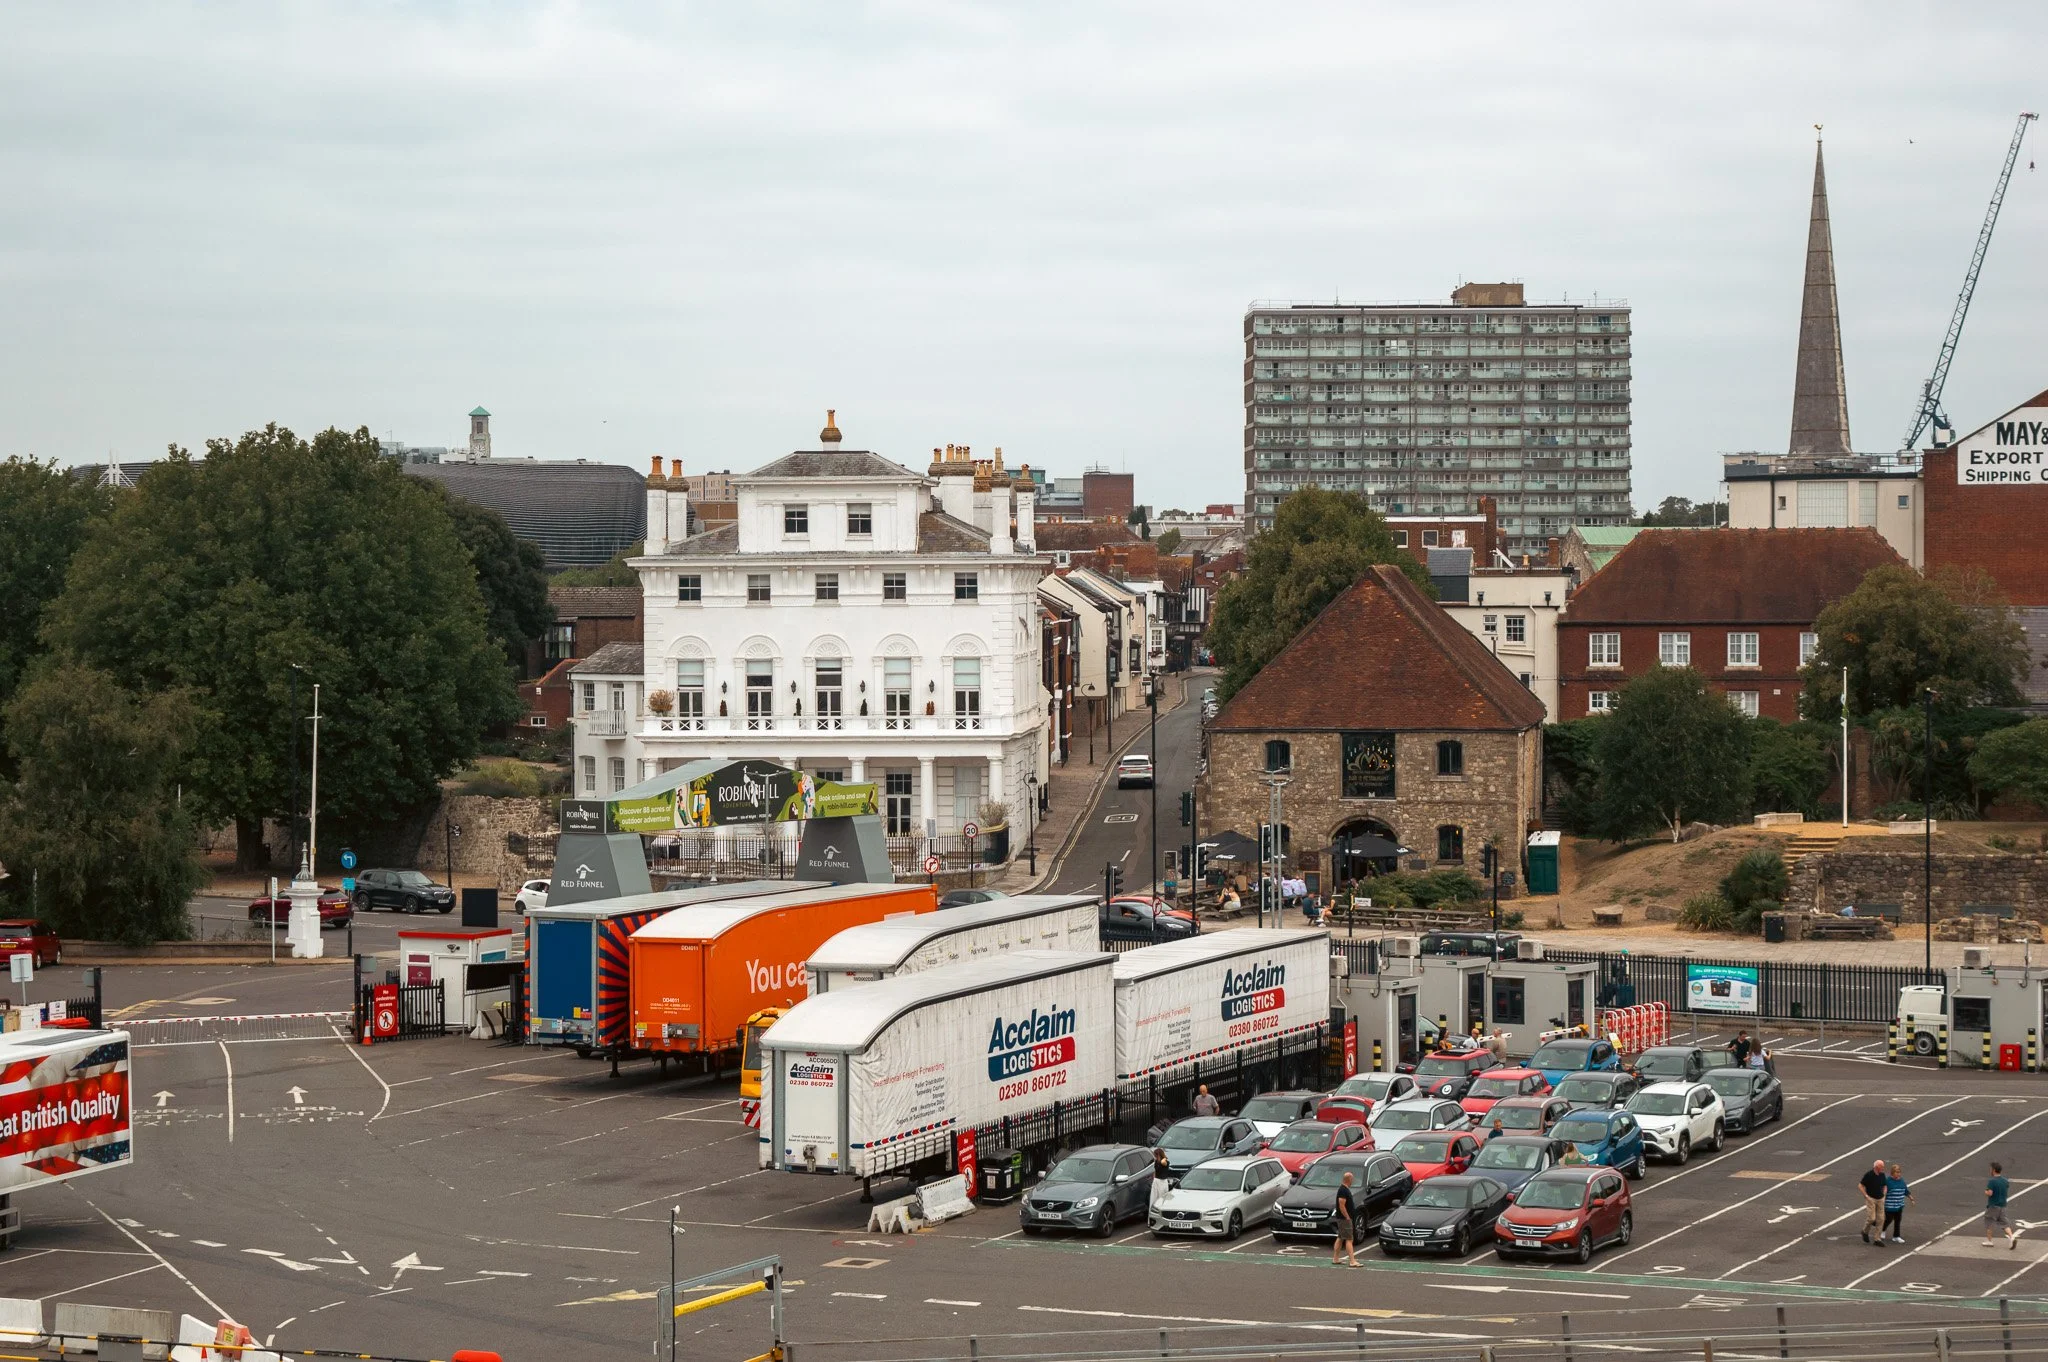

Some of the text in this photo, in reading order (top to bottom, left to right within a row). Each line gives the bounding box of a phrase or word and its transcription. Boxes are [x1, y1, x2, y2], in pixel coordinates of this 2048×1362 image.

[1970, 450, 2044, 464] EXPORT
[1966, 468, 2031, 482] SHIPPING
[718, 784, 780, 802] ROBIN HLL
[620, 807, 642, 815] Discover
[746, 958, 782, 994] You
[1221, 960, 1286, 999] Acclaim
[1231, 993, 1275, 1016] LOGISTICS
[988, 1004, 1075, 1054] Acclaim
[1229, 1014, 1278, 1038] 02380 860722
[790, 1063, 834, 1073] Acclaim
[1002, 1044, 1062, 1074] LOGISTICS
[999, 1069, 1066, 1101] 02380 860722
[22, 1101, 68, 1133] British
[70, 1090, 120, 1124] Quality
